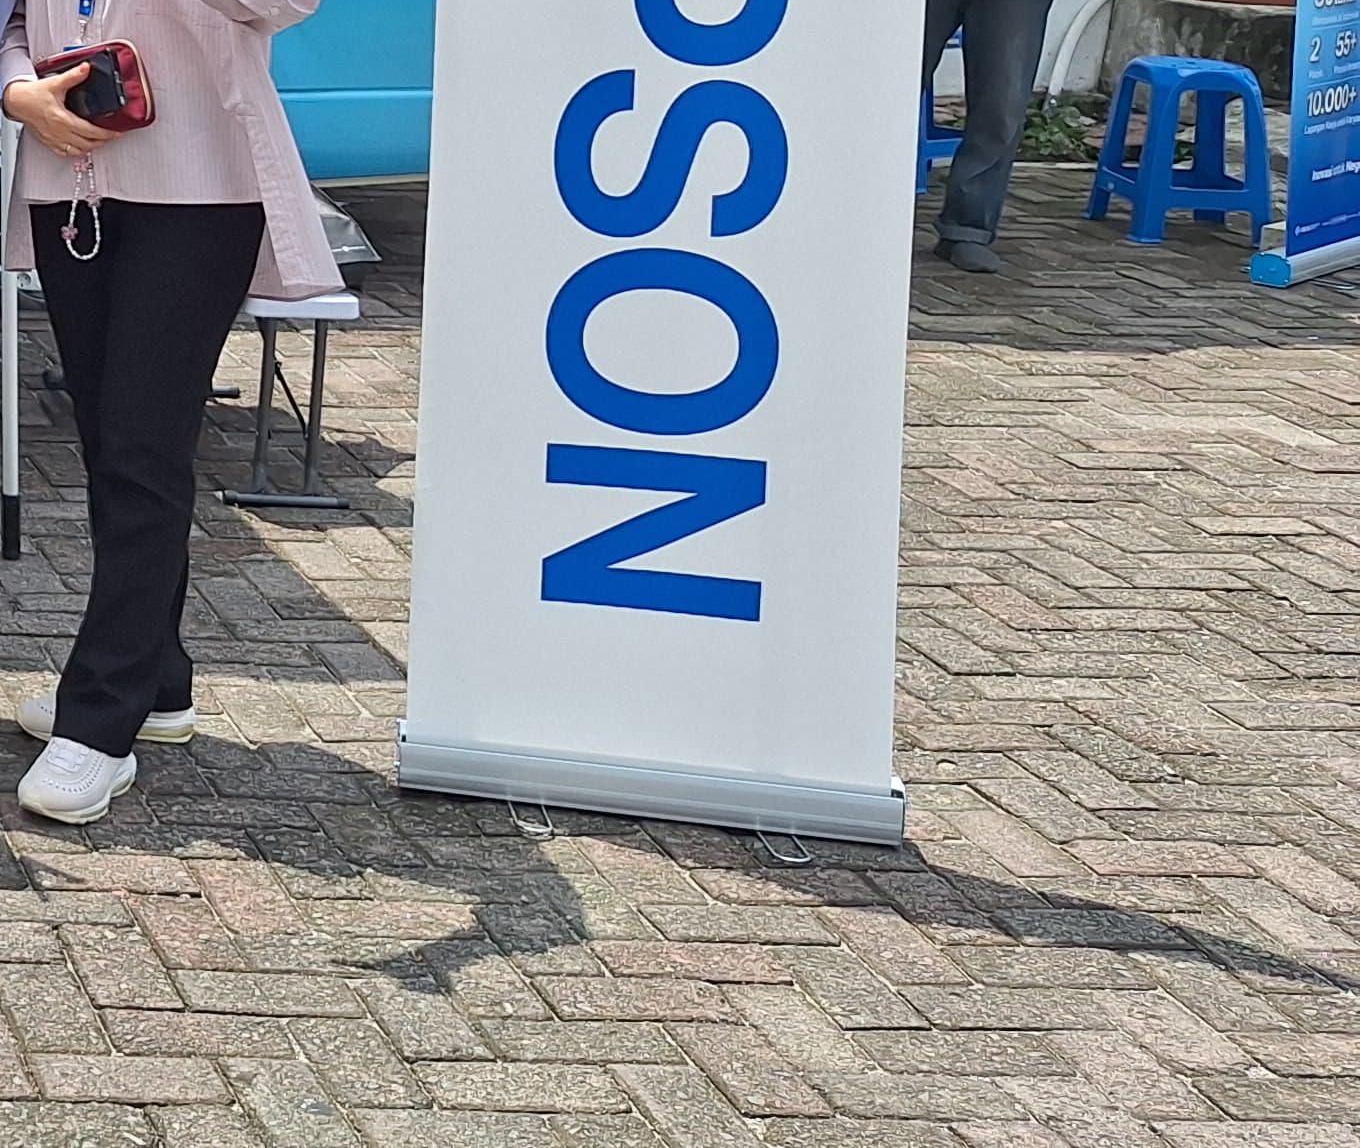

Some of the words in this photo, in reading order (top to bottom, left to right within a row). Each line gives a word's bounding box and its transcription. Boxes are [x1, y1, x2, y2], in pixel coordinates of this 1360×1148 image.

[1309, 36, 1321, 62] 2
[1335, 30, 1357, 57] 55+
[1307, 84, 1356, 117] 10.000+
